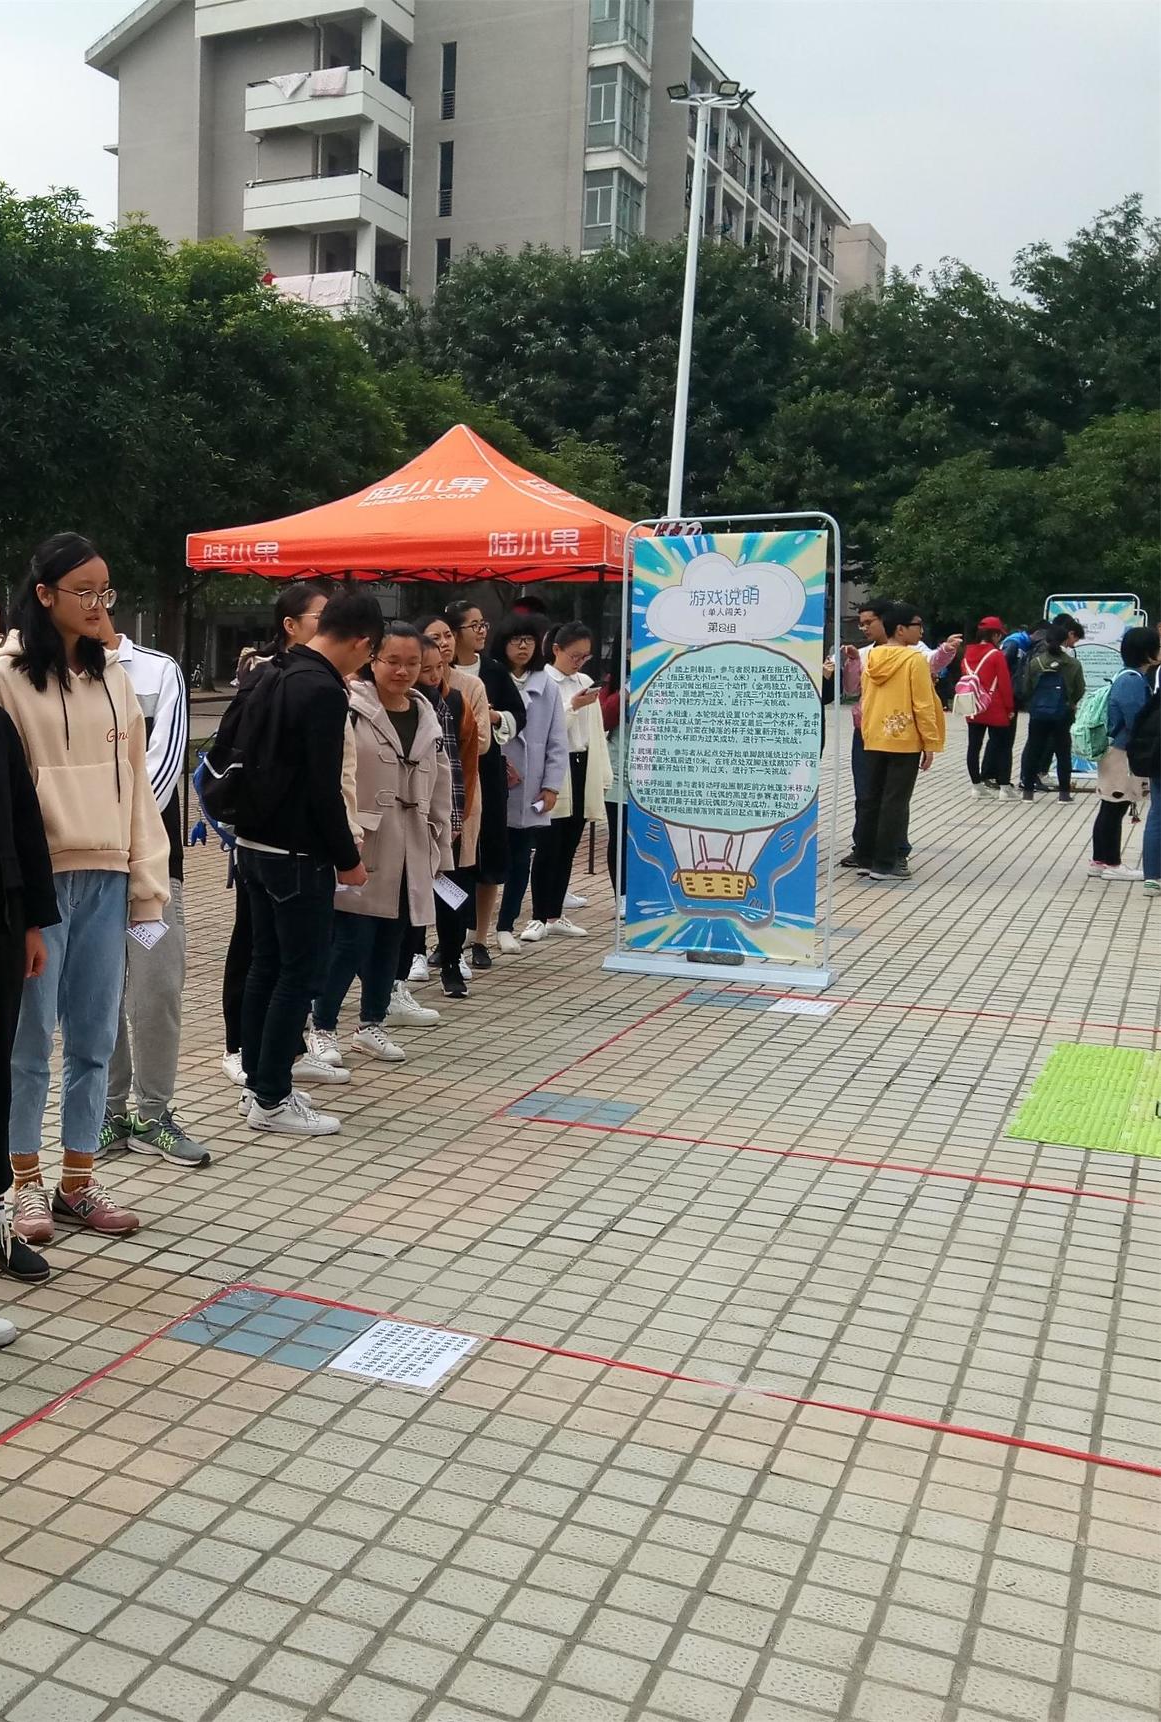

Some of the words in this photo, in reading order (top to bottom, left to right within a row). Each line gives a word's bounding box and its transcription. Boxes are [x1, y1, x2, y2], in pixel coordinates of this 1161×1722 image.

[363, 477, 489, 502] 陆小果
[203, 542, 279, 563] 陆小果
[488, 528, 580, 557] 陆小果
[689, 585, 760, 606] 游戏说明
[73, 1199, 98, 1219] N
